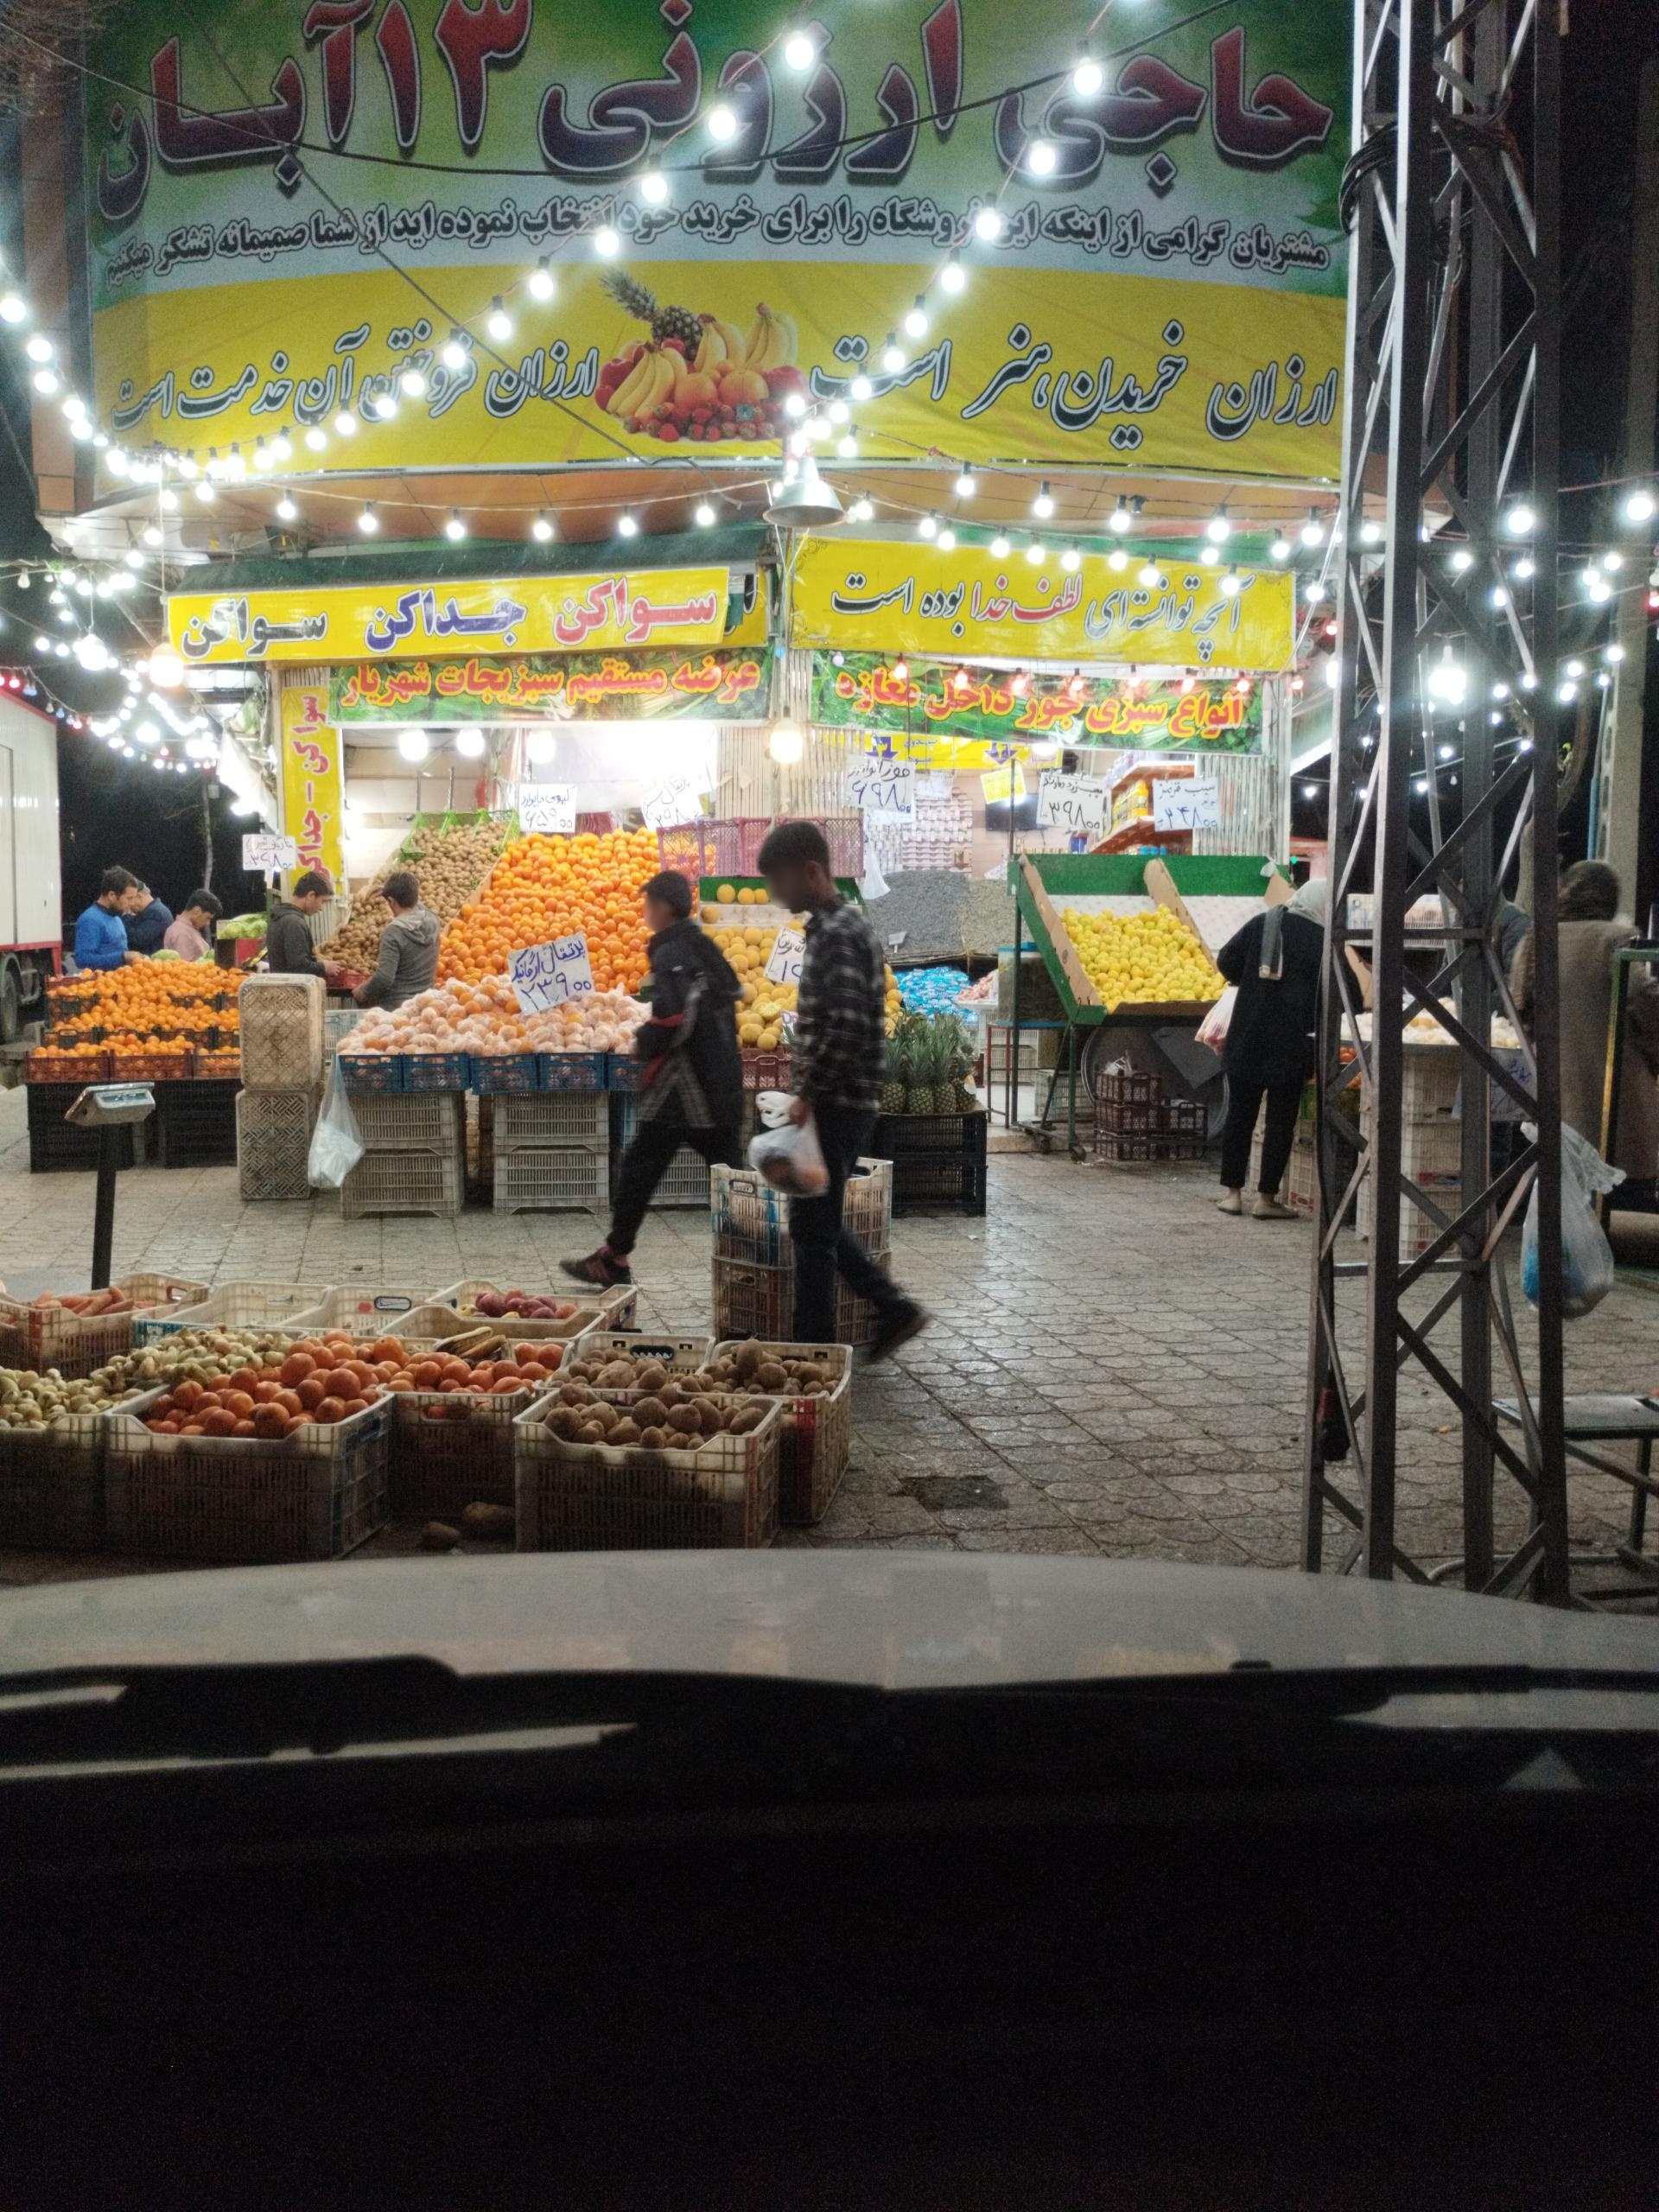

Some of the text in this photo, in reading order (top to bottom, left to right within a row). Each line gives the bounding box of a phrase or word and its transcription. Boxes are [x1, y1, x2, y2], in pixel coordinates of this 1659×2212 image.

[96, 0, 376, 221] آبان
[537, 0, 963, 175] ارزونی
[994, 24, 1335, 188] حاجی
[215, 218, 309, 263] صمیمانه
[308, 208, 359, 248] شما
[359, 202, 389, 254] از
[390, 200, 436, 249] اید
[436, 197, 518, 248] نموده
[518, 194, 617, 245] انتخاب
[618, 199, 682, 245] خود
[681, 193, 762, 245] خرید
[761, 193, 835, 245] برای
[834, 194, 868, 245] را
[1040, 205, 1112, 254] اینکه
[1110, 209, 1144, 257] از
[1142, 215, 1231, 265] گرامی
[153, 224, 215, 276] تشکر
[1229, 224, 1331, 275] مشتریان
[175, 351, 290, 420] خدمت
[294, 322, 371, 423] آن
[484, 340, 600, 419] ارزان
[810, 335, 952, 400] است
[111, 370, 174, 432] است
[1205, 354, 1338, 442] ارزان
[364, 584, 527, 653] جداکن
[553, 578, 719, 646] سواکن
[831, 573, 914, 614] است
[919, 582, 965, 637] بوده
[970, 574, 1014, 622] خدا
[1012, 573, 1084, 624] لطف
[182, 596, 328, 660] سواکن
[341, 655, 760, 707] عرضه مستقیم سبزیجات شهریار
[835, 666, 1245, 740] انواع سبزی جور داخل مغازه
[541, 940, 586, 975] پرتقال
[520, 972, 592, 1011] ۲۳۹۰۰
